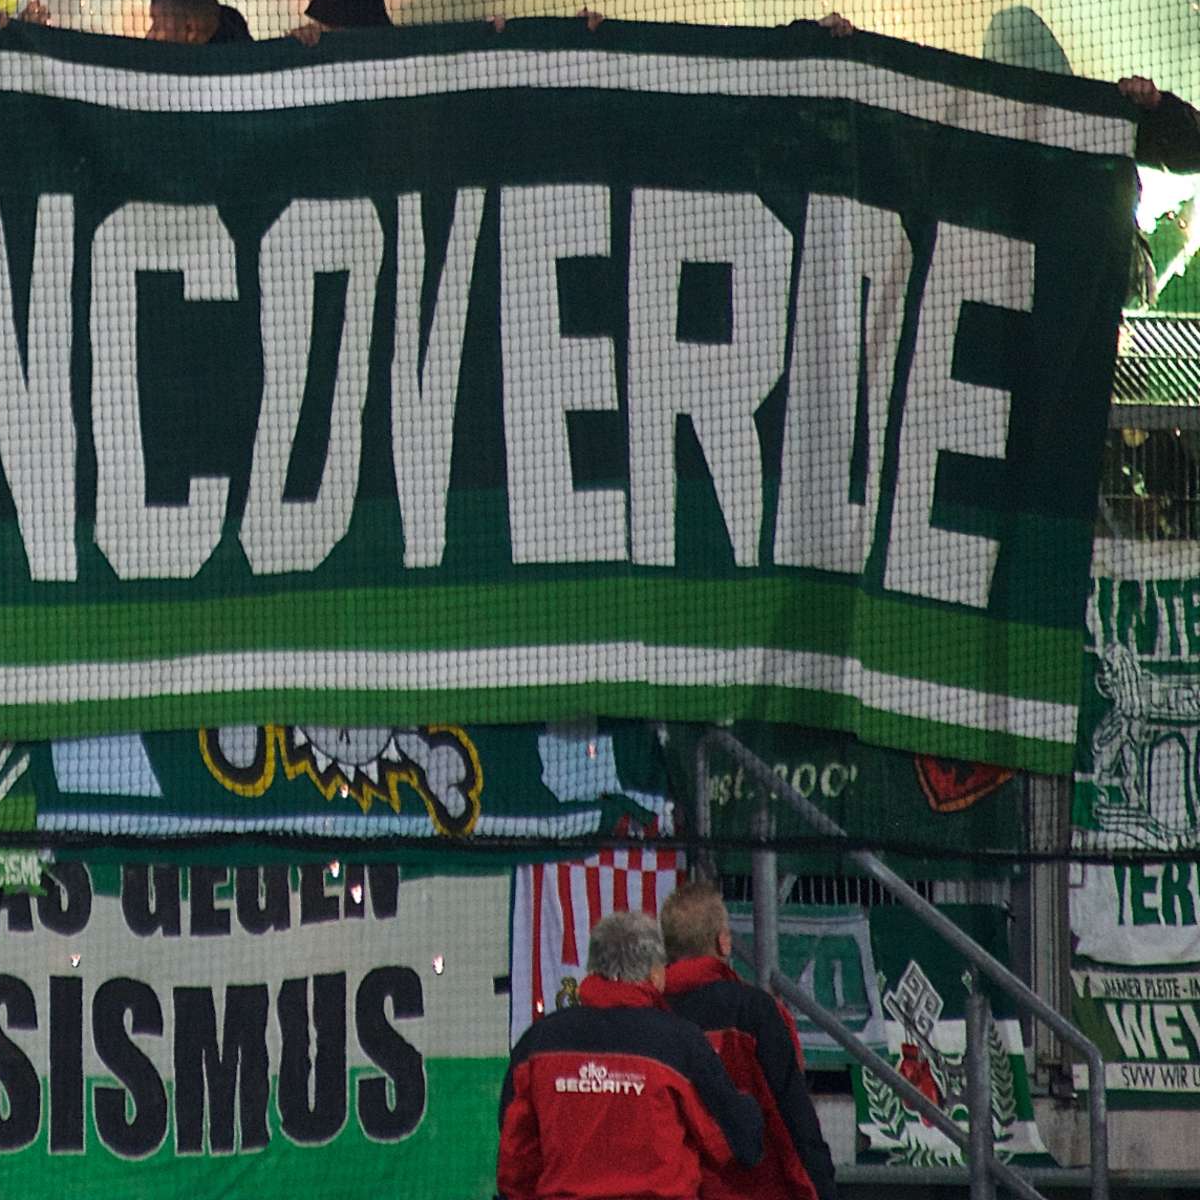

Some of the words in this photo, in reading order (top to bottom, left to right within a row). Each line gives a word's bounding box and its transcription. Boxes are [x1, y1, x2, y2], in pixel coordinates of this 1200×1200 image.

[555, 1077, 645, 1096] SECURITY
[1121, 1066, 1156, 1087] SVW
[1159, 1067, 1188, 1088] WIR
